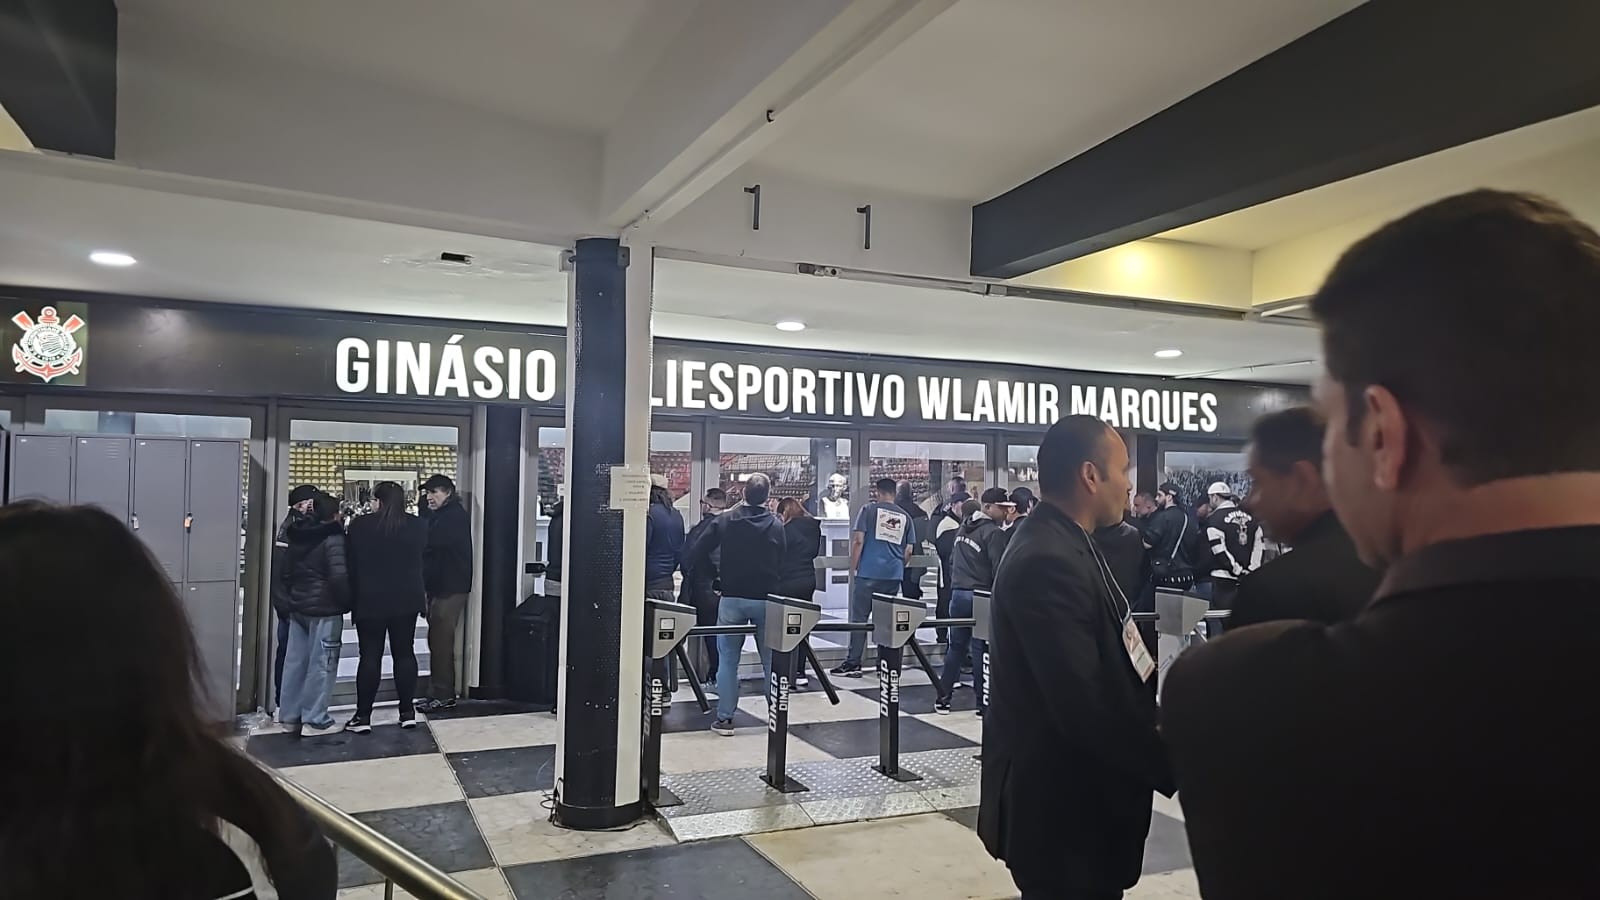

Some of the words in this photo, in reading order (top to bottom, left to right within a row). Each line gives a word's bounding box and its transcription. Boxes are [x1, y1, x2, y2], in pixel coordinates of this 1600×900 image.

[336, 334, 556, 401] GINÁSIO
[918, 376, 1059, 425] WLAMIR
[1071, 384, 1218, 432] MARQUES
[651, 678, 663, 716] DIMEP
[769, 671, 778, 732] DIMEP
[779, 676, 789, 711] DIMEP
[880, 659, 889, 717] DIMEP
[890, 669, 899, 703] DIMEP
